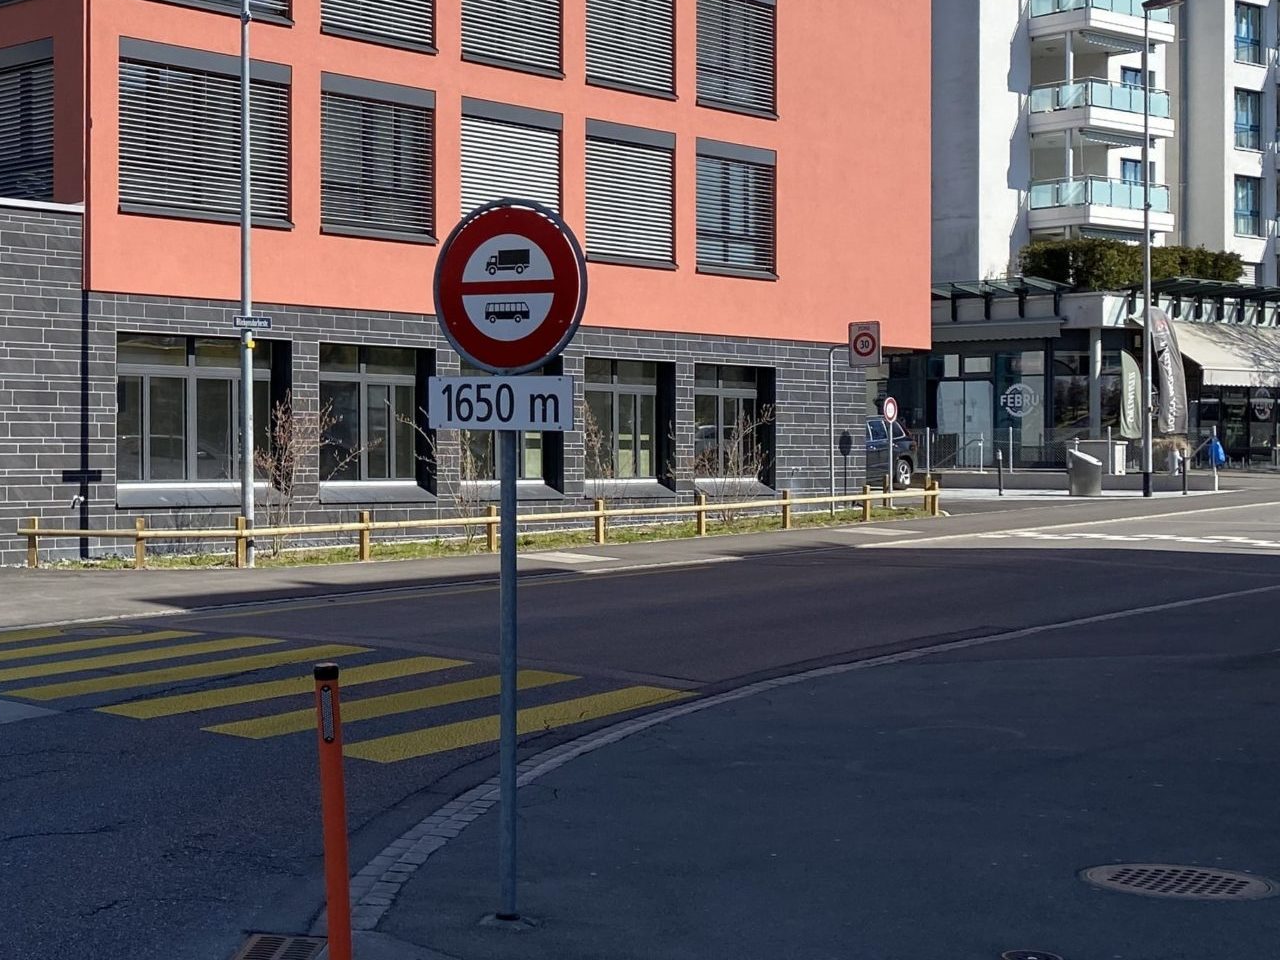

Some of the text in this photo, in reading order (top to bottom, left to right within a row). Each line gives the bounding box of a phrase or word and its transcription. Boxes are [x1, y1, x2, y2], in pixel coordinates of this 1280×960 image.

[860, 340, 870, 349] 30
[441, 383, 560, 423] 1650 m
[1000, 394, 1040, 407] FEBRU
